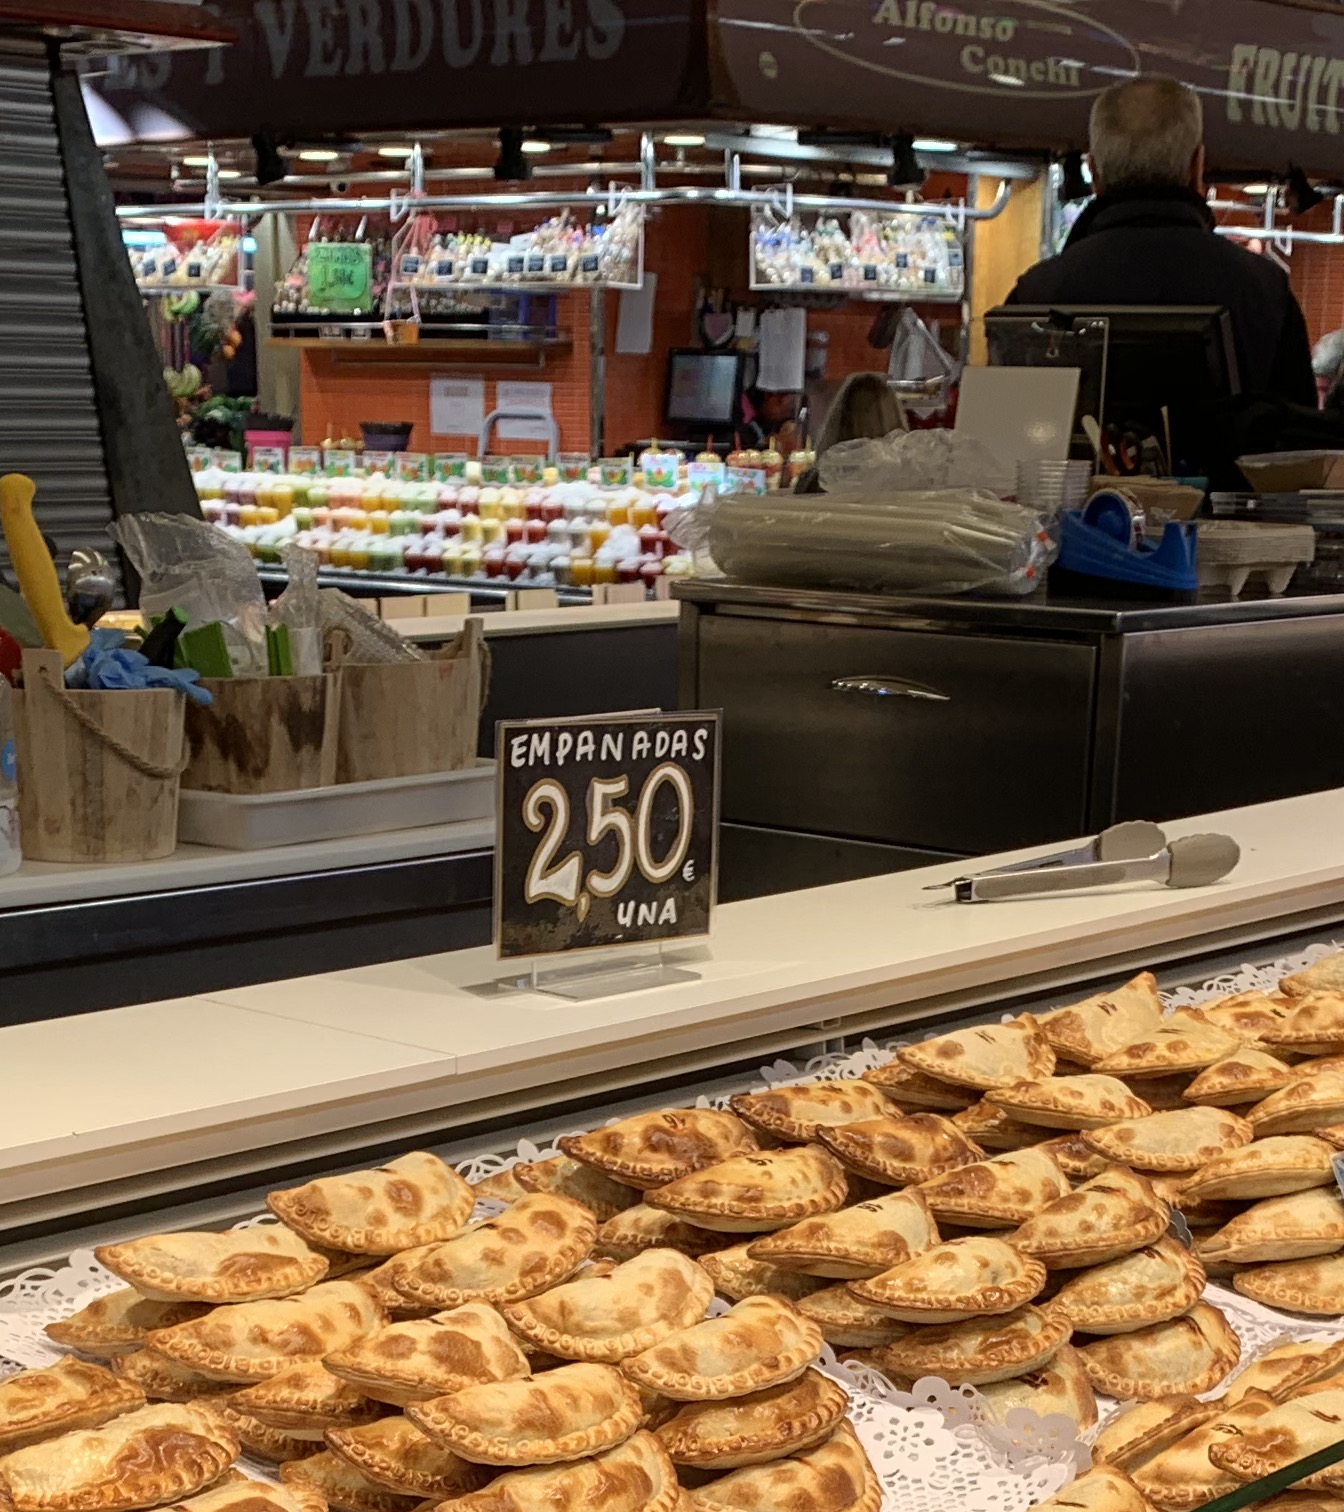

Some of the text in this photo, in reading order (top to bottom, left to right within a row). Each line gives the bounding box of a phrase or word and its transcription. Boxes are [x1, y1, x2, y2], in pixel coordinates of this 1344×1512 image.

[258, 0, 626, 79] VERDURES
[871, 0, 1017, 42] Alfonso
[960, 44, 1080, 87] Conchi
[510, 728, 708, 768] EMPANADAS
[617, 897, 677, 928] UNA
